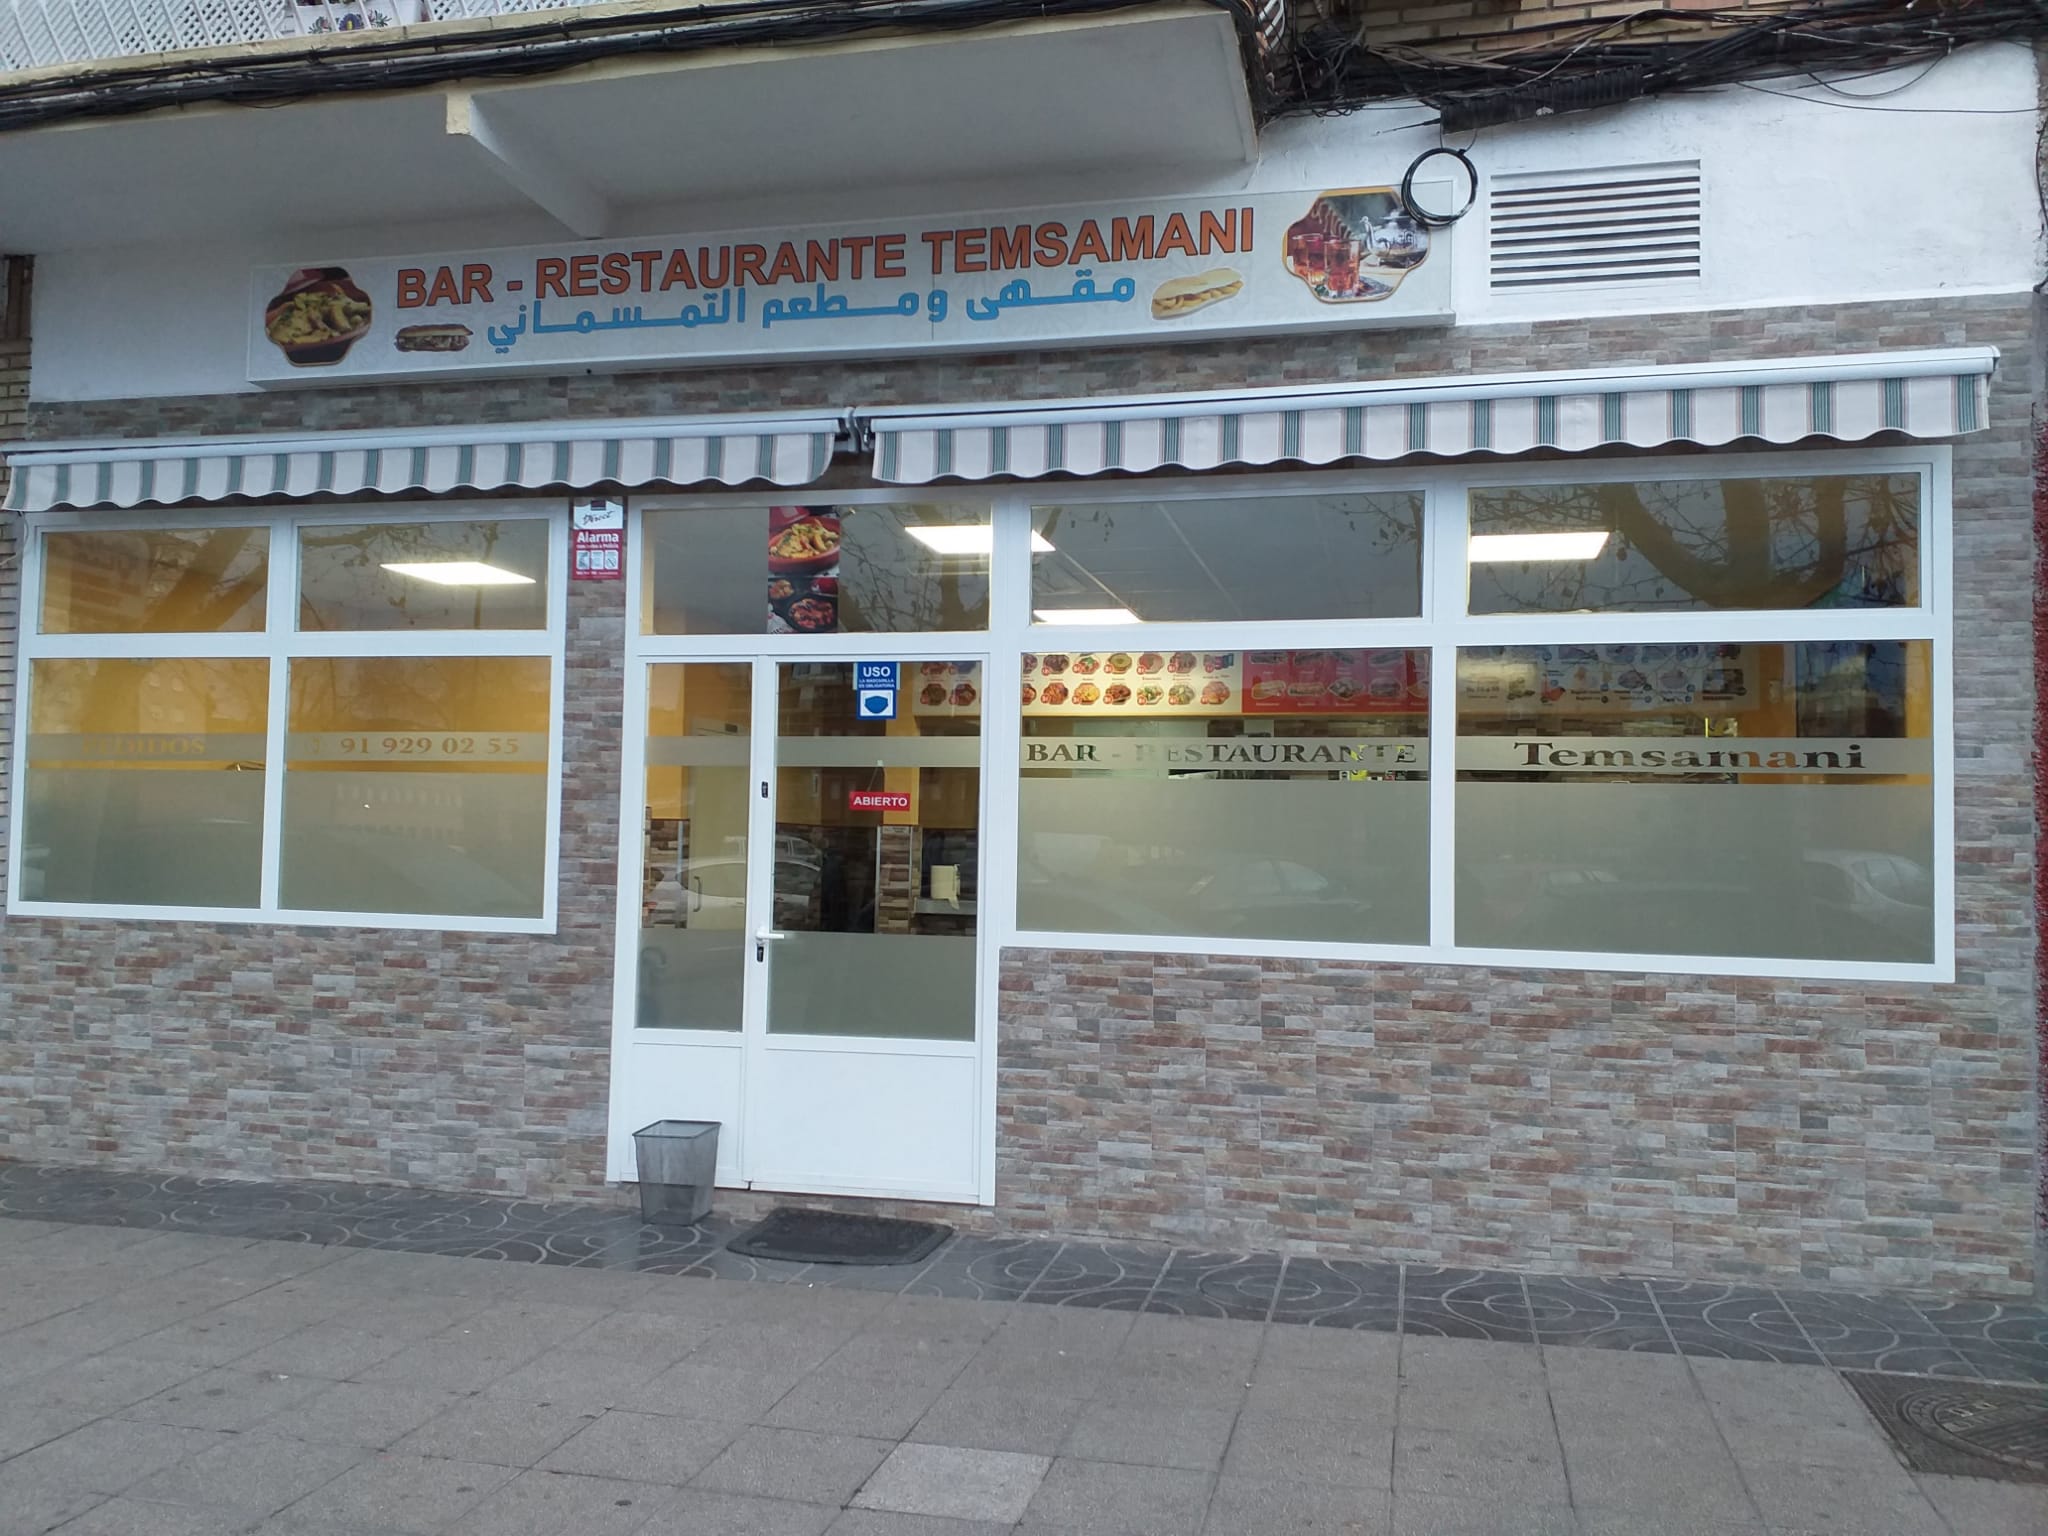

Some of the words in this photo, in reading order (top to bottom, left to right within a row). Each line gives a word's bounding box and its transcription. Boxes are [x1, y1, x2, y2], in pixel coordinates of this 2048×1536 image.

[397, 262, 495, 309] BAR
[535, 233, 907, 299] RESTAURANTE
[921, 206, 1254, 275] TEMSAMANI
[965, 268, 1136, 321] مقهى
[487, 287, 746, 354] التمسماني
[577, 531, 619, 543] Alarma
[862, 666, 891, 678] USO
[340, 737, 369, 754] 91
[382, 737, 433, 754] 929
[442, 737, 475, 754] 02
[487, 737, 520, 755] 55
[1026, 743, 1101, 762] BAR
[1513, 741, 1867, 769] Temsamani
[853, 796, 908, 807] ABIERTO
